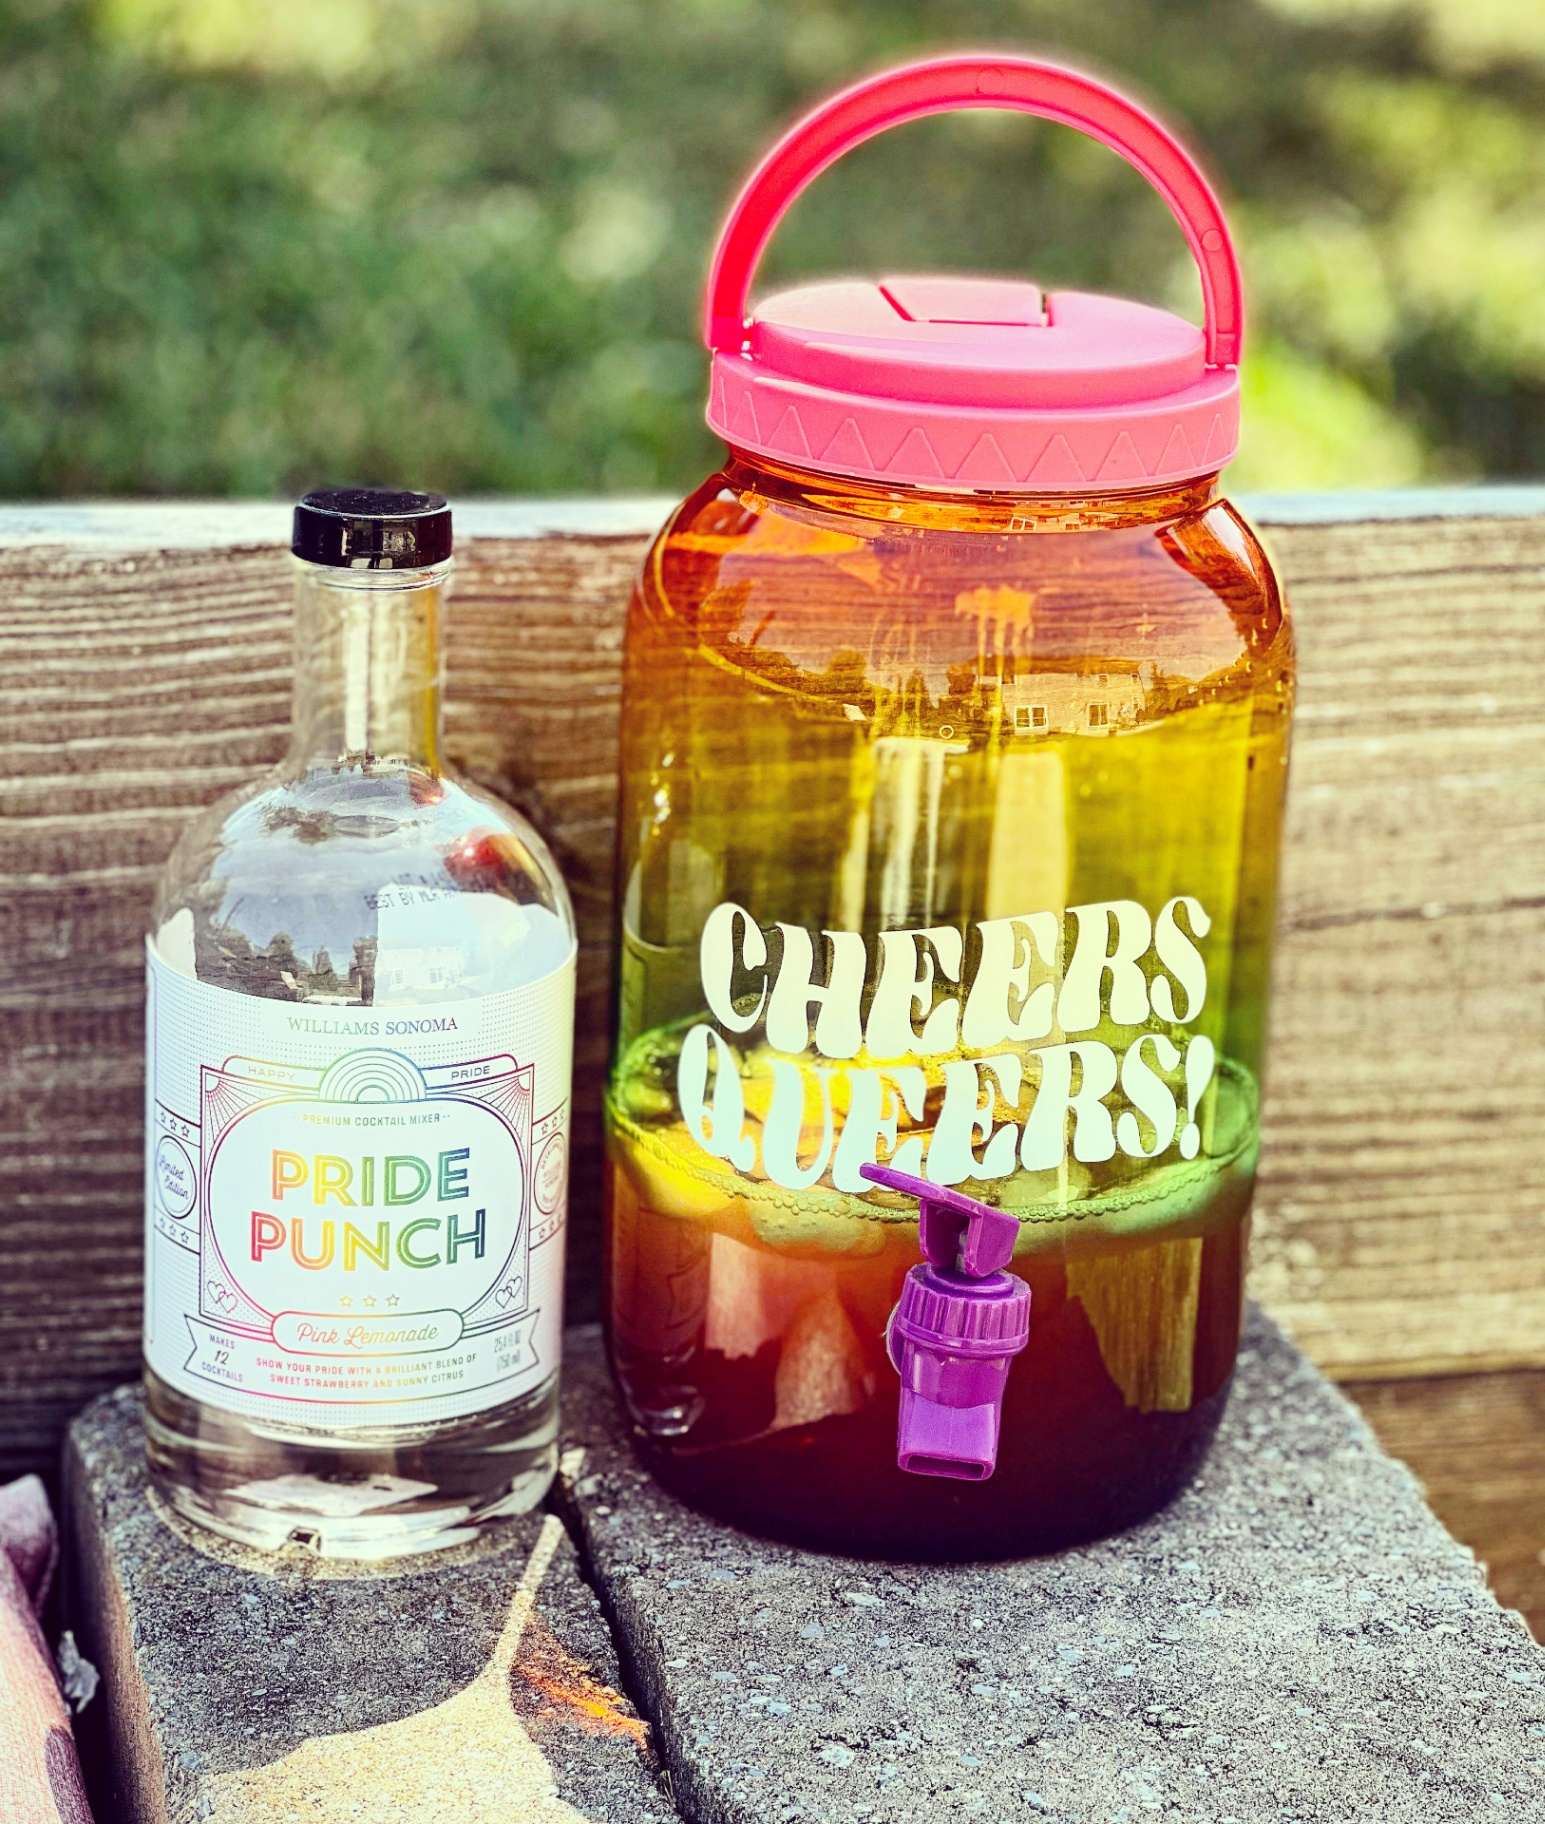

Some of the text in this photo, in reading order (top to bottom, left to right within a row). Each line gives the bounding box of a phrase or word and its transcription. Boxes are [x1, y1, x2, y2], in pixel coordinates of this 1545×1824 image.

[701, 896, 1211, 1058] CHEERS
[287, 1016, 459, 1036] WILLIAMS SONOMA
[248, 1065, 491, 1081] HAPPY PRIDE
[302, 1113, 441, 1127] PREMIUM COCKTAIL MIXER
[678, 1024, 1215, 1194] QUEERS!
[272, 1147, 470, 1207] PRIDE
[251, 1208, 486, 1271] PUNCH
[209, 1333, 235, 1350] MAKES
[297, 1322, 439, 1350] Pink Lemonade
[213, 1349, 230, 1365] 12
[256, 1352, 477, 1376] SHOW YOUR PRIDE WITH A BRILLIANT BLEND OF
[201, 1361, 244, 1383] COCKTAILS
[270, 1369, 464, 1389] SWEET STRAWBERRY AND SUNNY CITRUS
